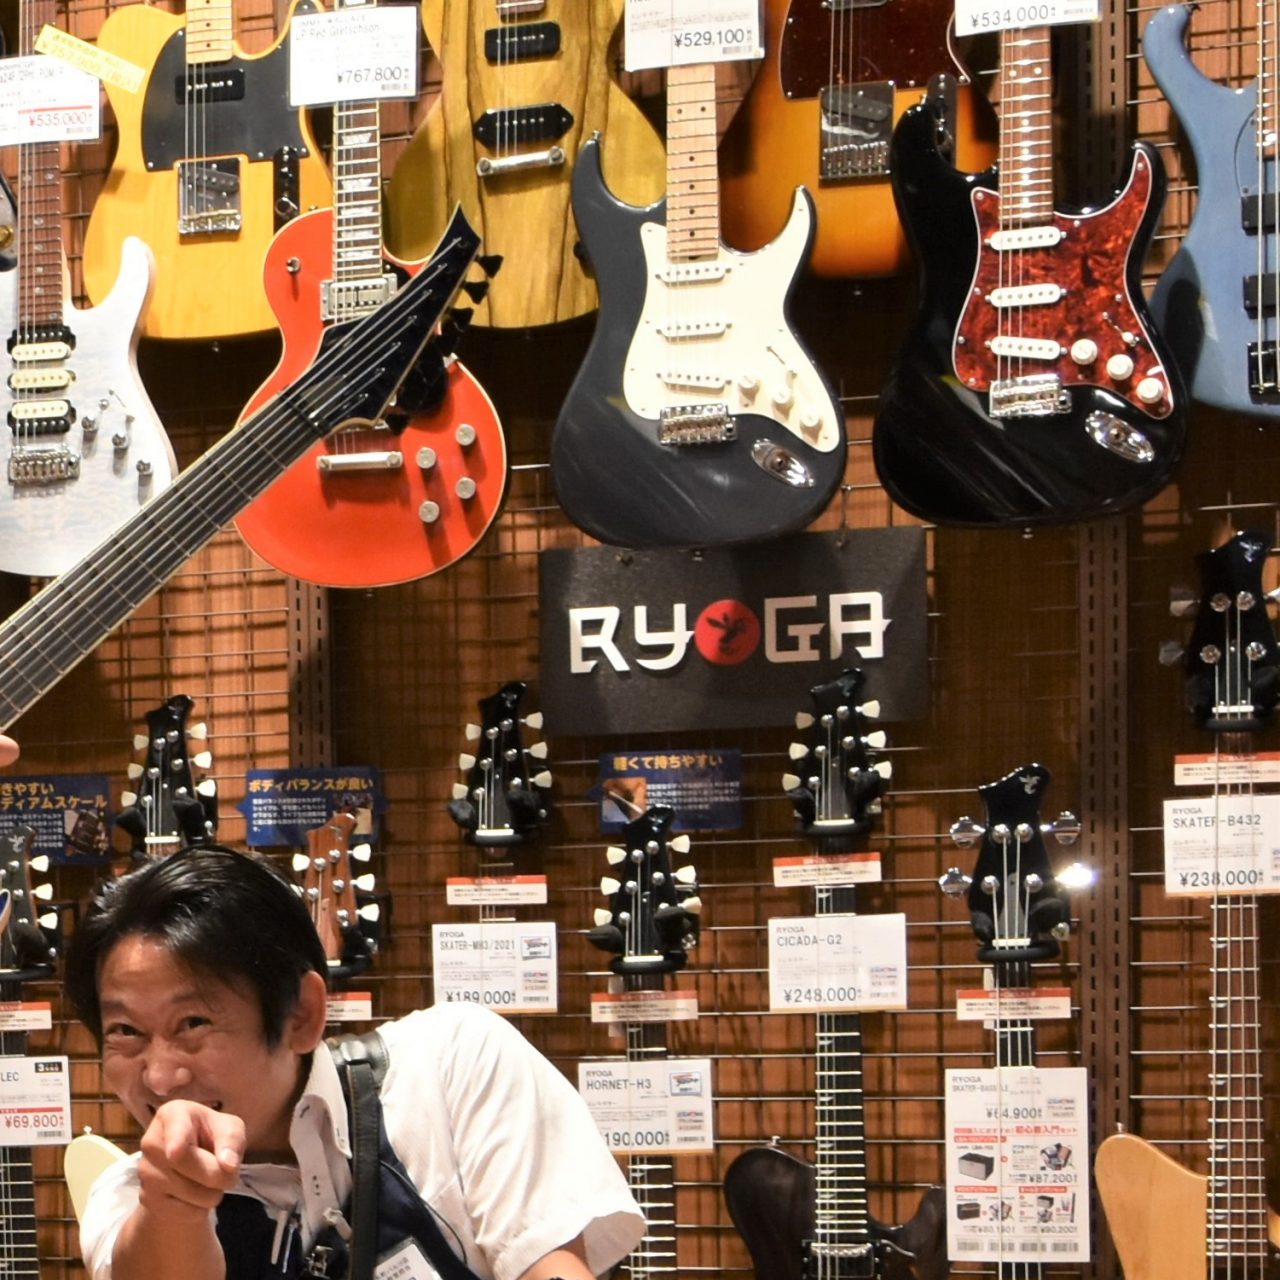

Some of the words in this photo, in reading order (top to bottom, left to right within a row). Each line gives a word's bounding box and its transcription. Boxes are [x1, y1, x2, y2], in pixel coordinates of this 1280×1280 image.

[249, 777, 374, 792] ボディバランスが良い
[1172, 807, 1202, 815] RYOGA
[1180, 869, 1258, 888] ¥238,000
[776, 934, 842, 947] CICADA-G2
[446, 990, 511, 1004] ¥189000
[784, 986, 857, 1003] ¥248,000
[586, 1078, 652, 1090] HORNET-H3
[5, 1114, 58, 1128] ¥69,800
